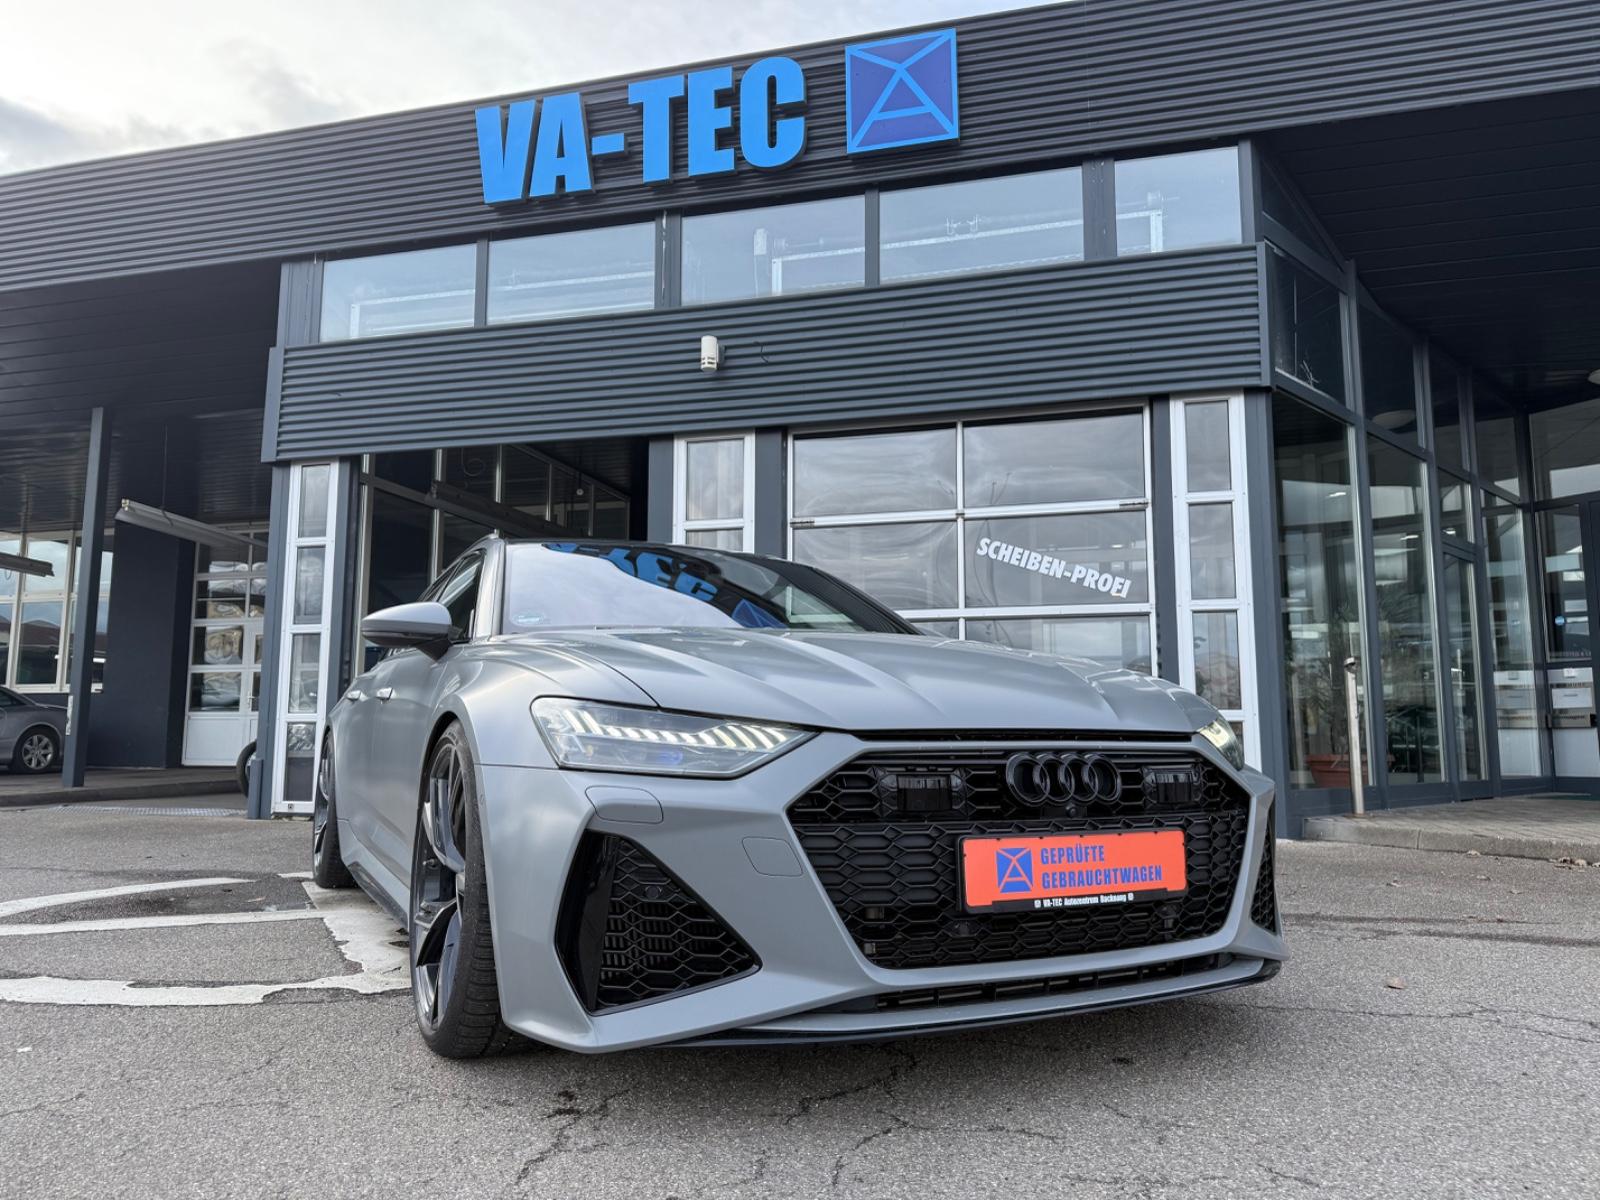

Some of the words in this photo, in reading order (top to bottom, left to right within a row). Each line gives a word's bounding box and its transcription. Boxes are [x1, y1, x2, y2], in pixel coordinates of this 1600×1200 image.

[475, 56, 807, 204] VA-TEC
[976, 537, 1132, 598] SCHEIBEN-PROFI
[1041, 844, 1104, 864] GEPRÜFTE
[1042, 866, 1162, 889] GEBRAUCHTWAGEN
